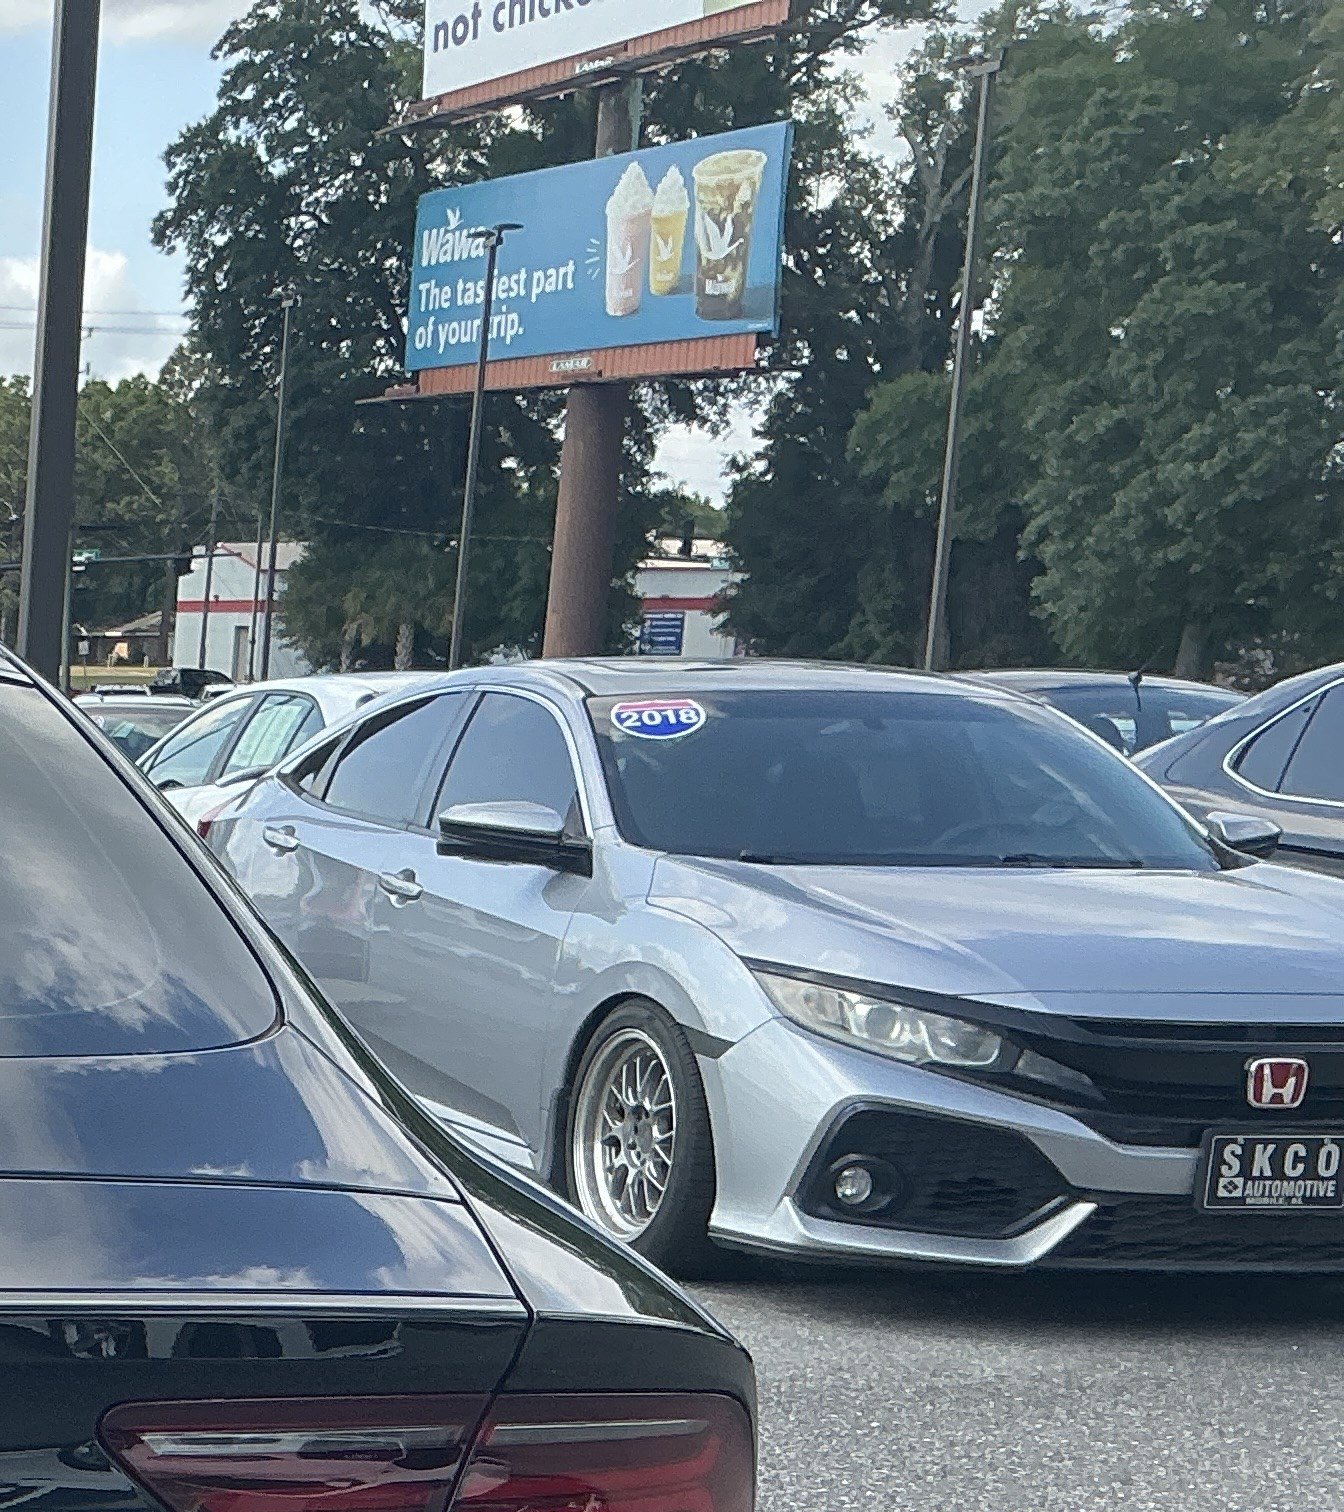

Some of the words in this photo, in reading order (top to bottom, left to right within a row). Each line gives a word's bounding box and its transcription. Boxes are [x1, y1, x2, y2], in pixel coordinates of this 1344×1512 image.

[433, 2, 482, 53] not
[421, 226, 487, 268] Wawa
[418, 278, 452, 313] The
[457, 267, 528, 307] tasiest
[531, 260, 576, 304] part
[414, 316, 436, 350] of
[438, 319, 481, 354] your
[620, 708, 700, 727] 2018
[1220, 1143, 1341, 1178] SKCO
[1244, 1179, 1337, 1198] AUTOMOTIVE
